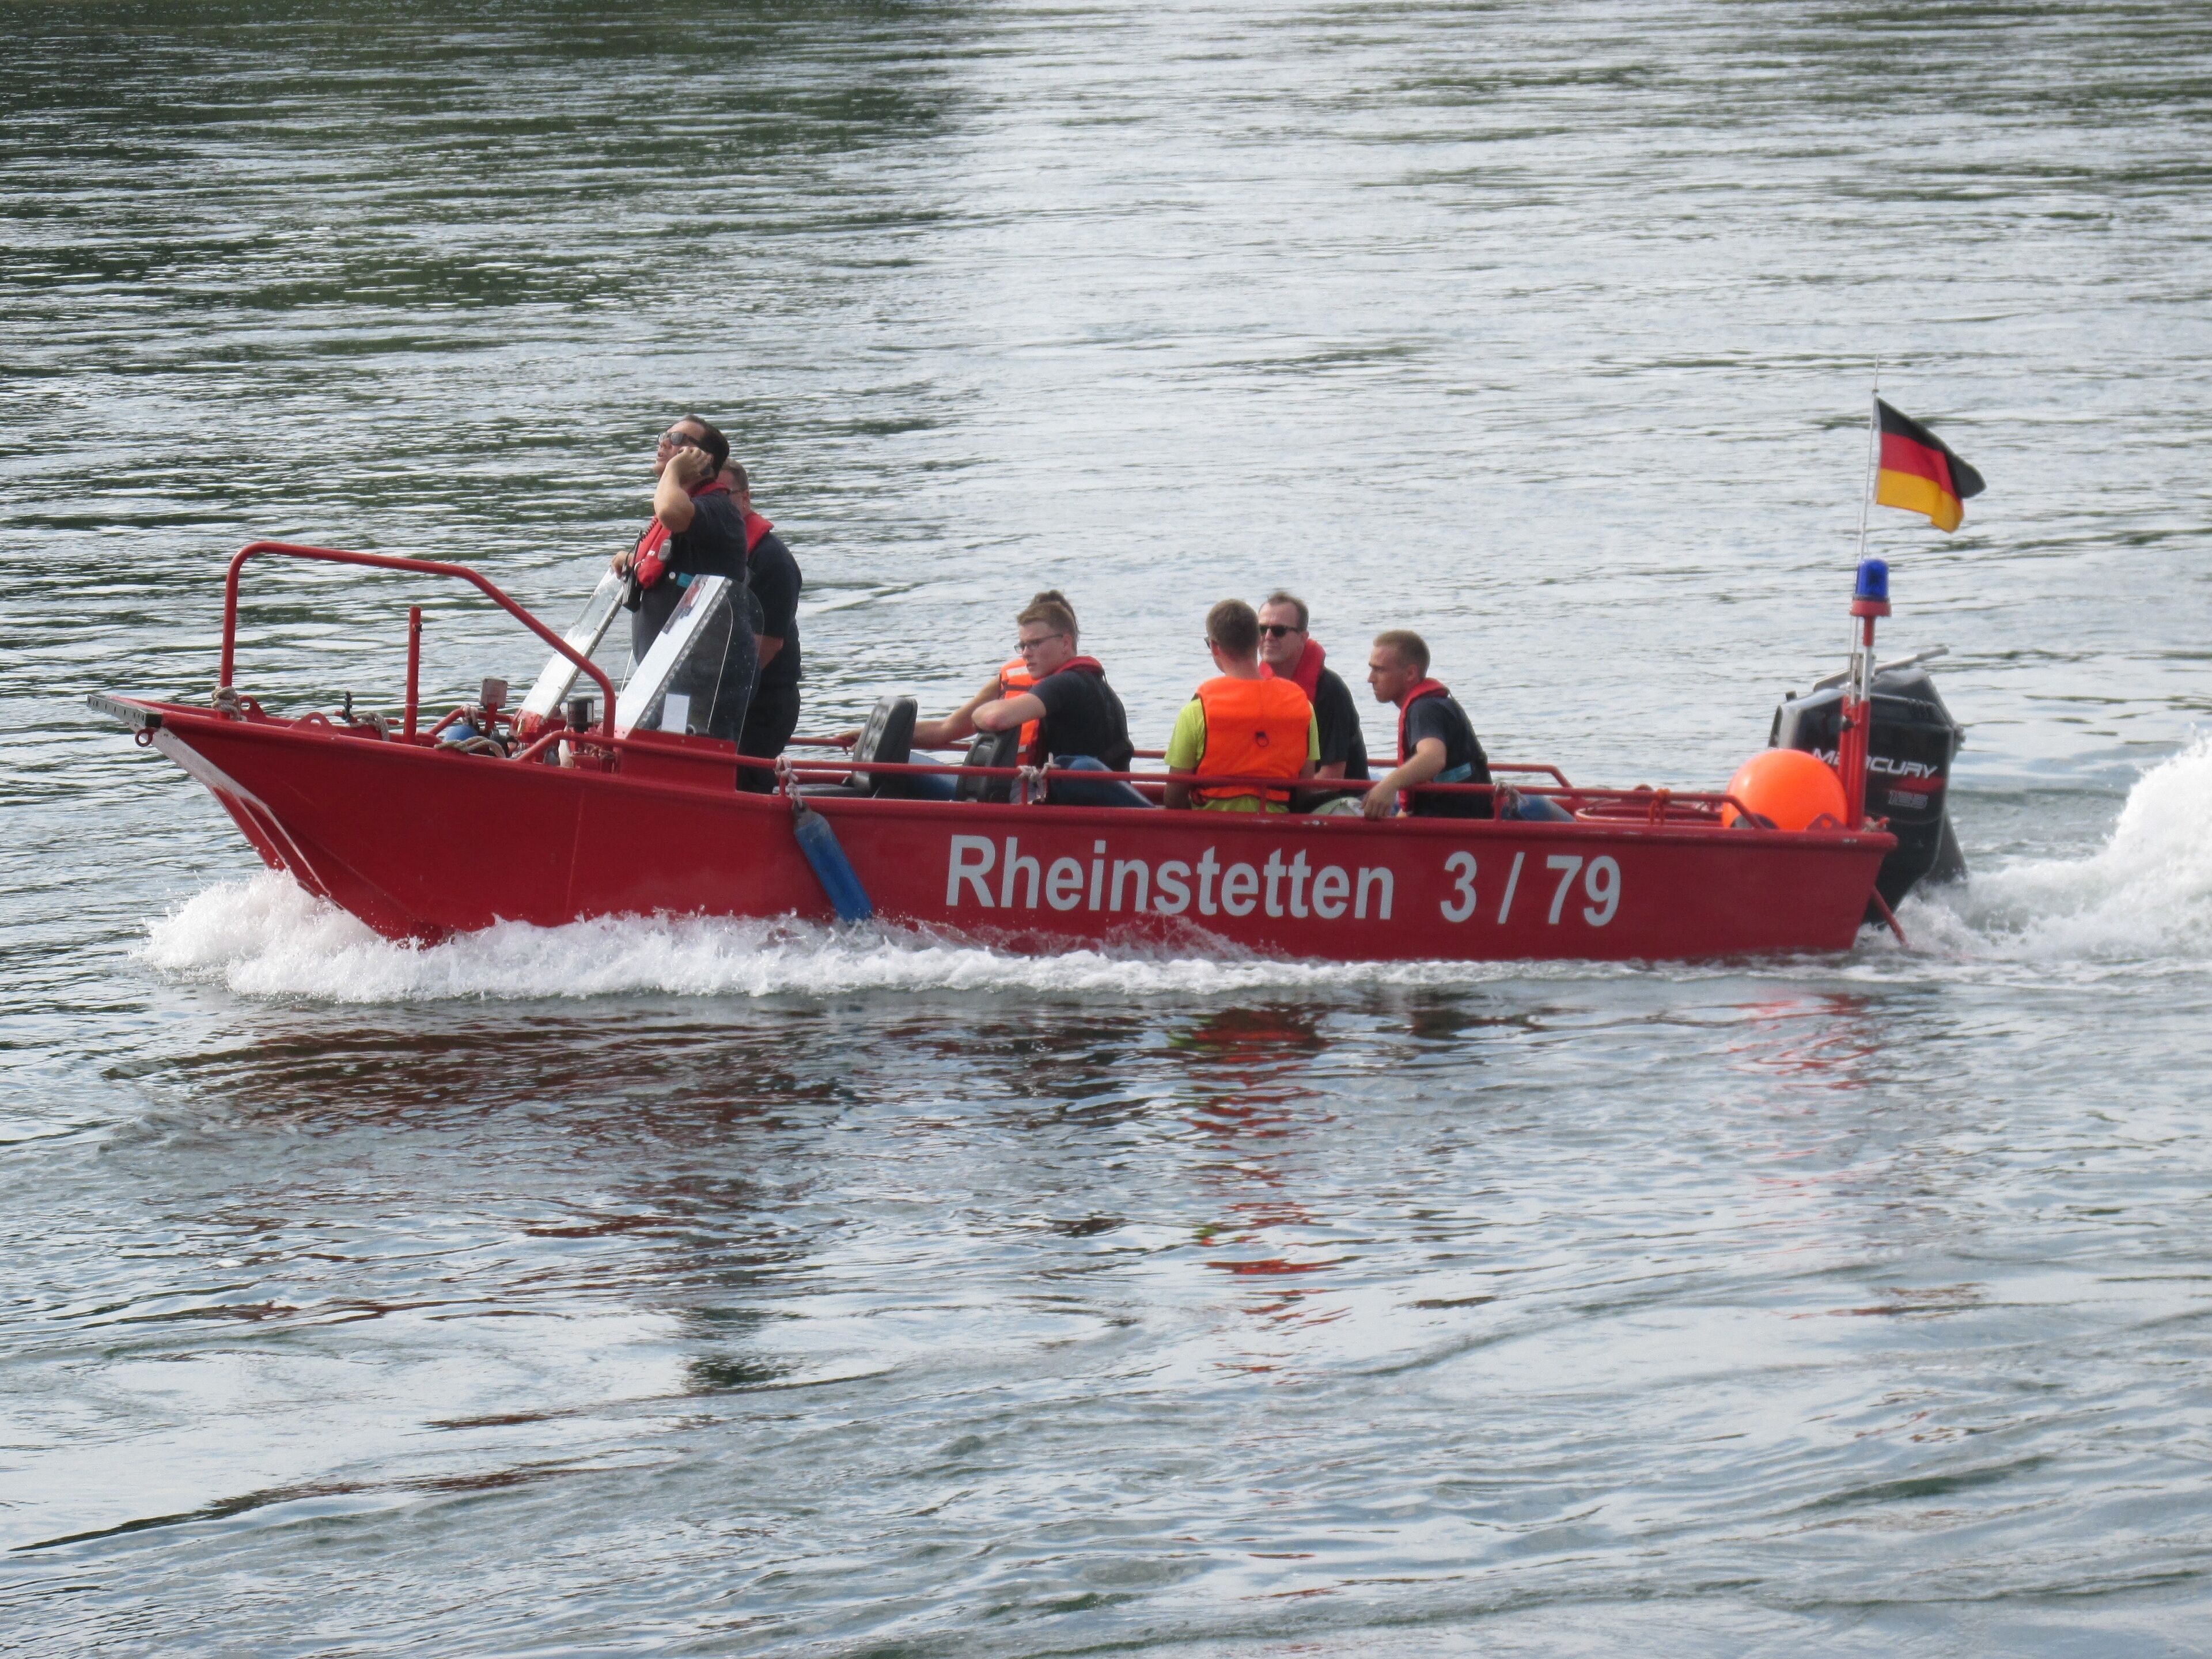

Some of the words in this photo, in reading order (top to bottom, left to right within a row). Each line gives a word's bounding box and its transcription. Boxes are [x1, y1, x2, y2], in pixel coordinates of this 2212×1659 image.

[945, 834, 1395, 920] Rheinstetten
[1440, 851, 1478, 923] 3
[1497, 851, 1525, 925] /
[1546, 854, 1622, 927] 79
